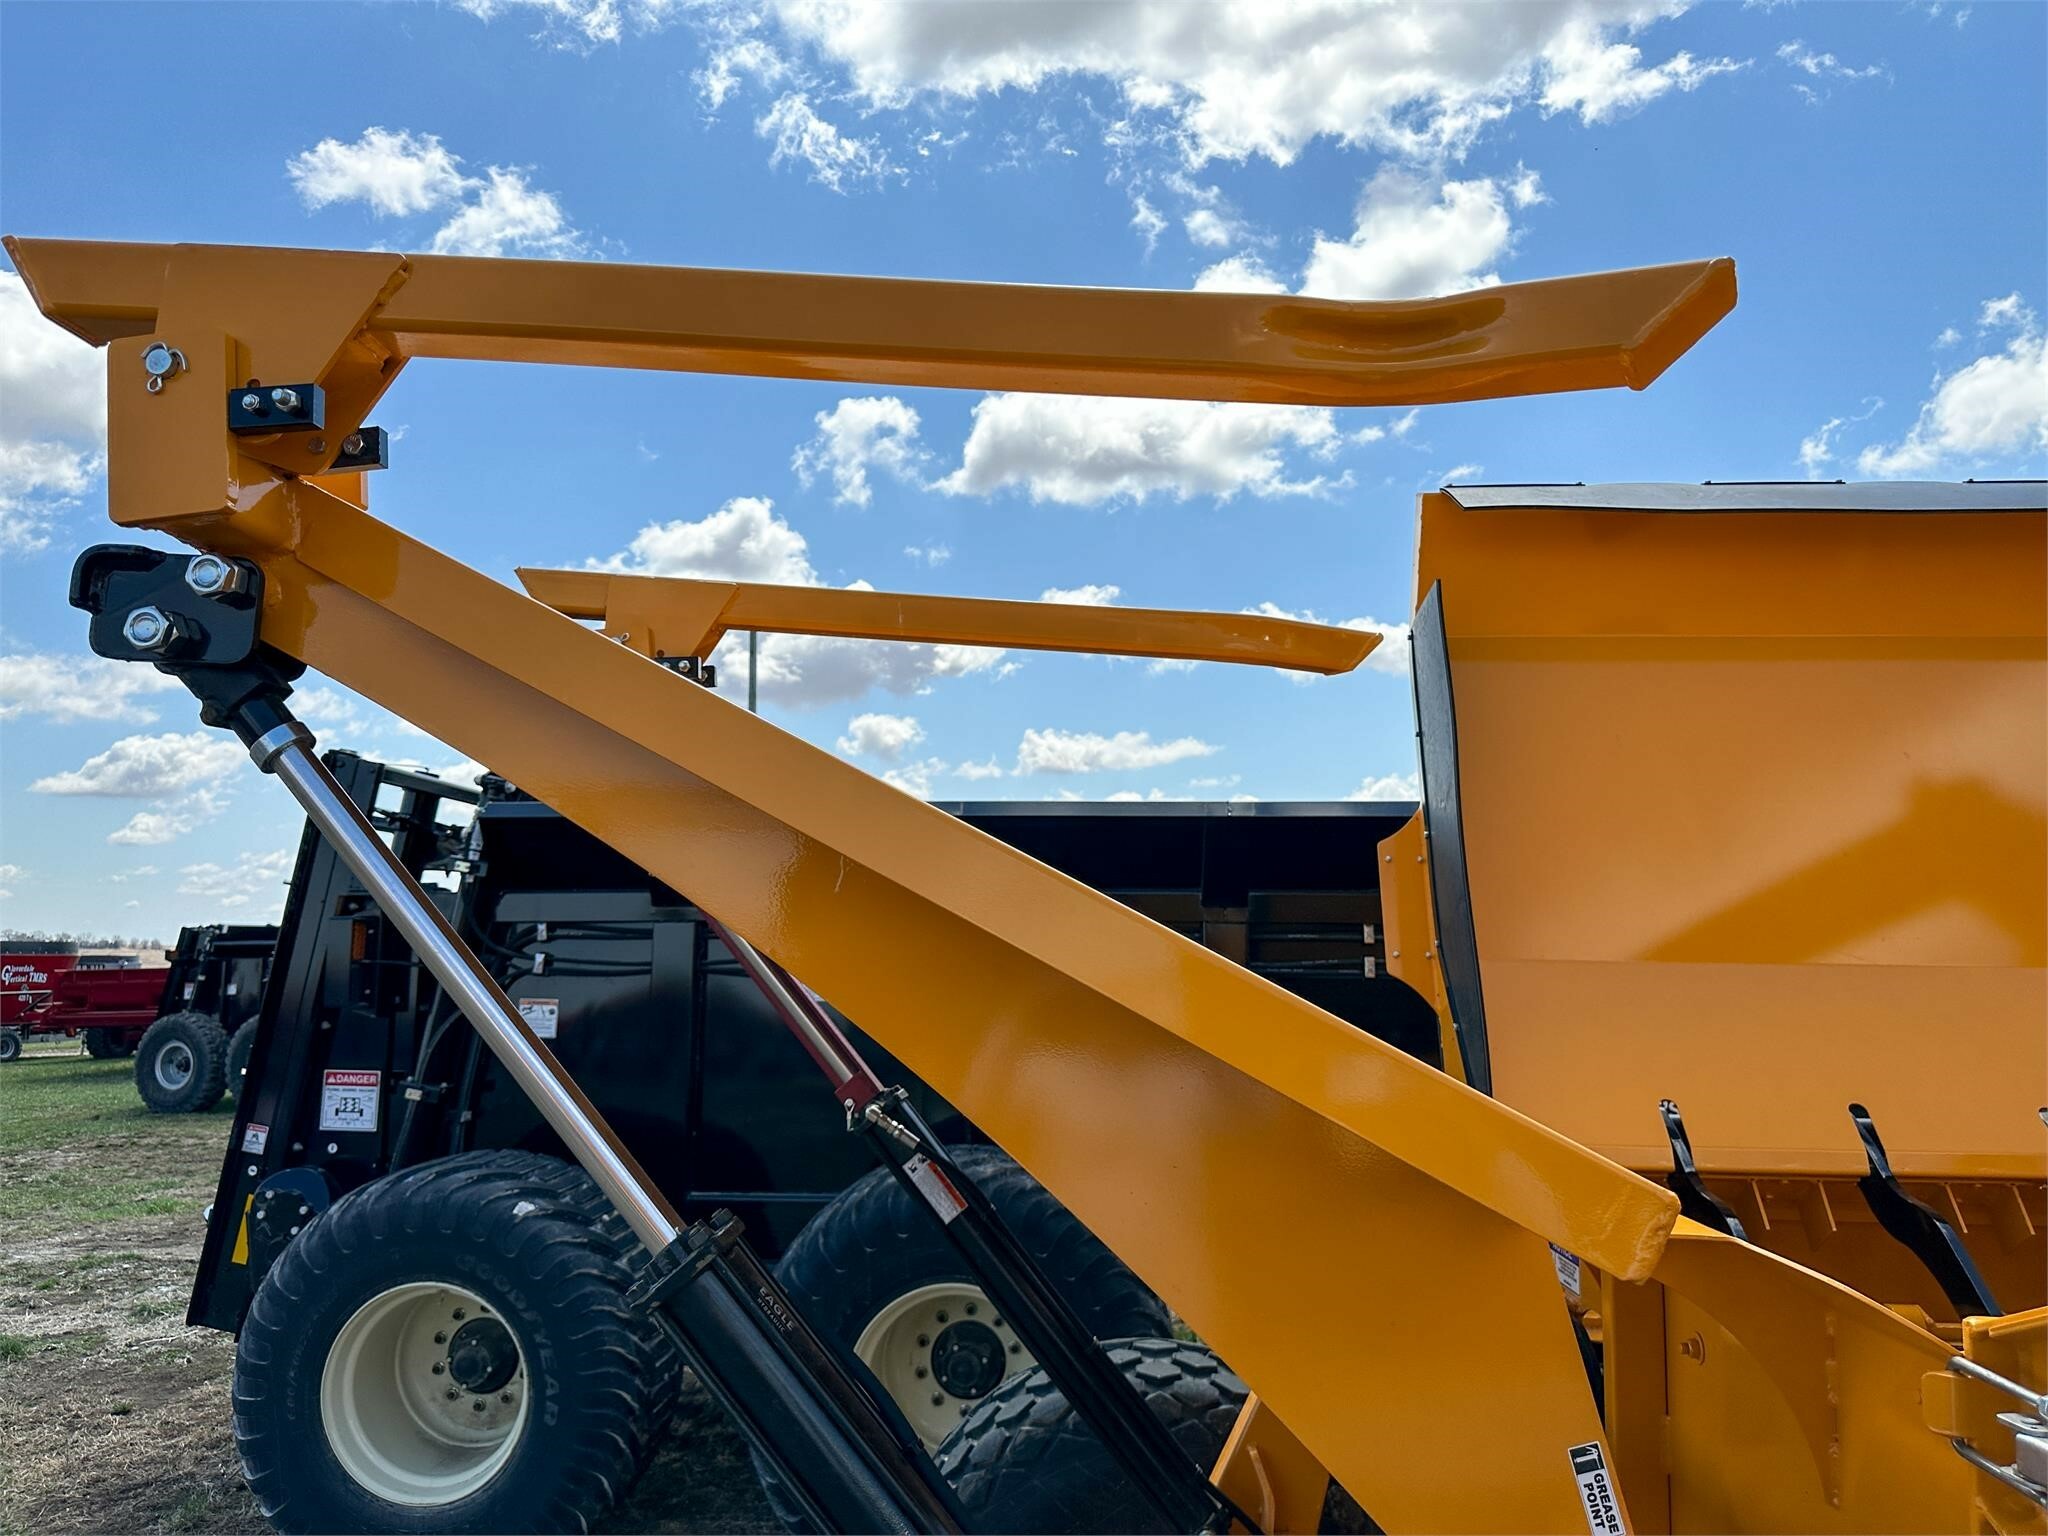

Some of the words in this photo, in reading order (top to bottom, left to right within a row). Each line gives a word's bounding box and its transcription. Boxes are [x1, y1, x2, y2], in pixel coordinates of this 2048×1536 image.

[29, 972, 48, 983] TMRS
[336, 1074, 377, 1084] DANGER
[760, 1286, 794, 1331] EAGLE
[455, 1254, 560, 1427] GOODYEAR
[1583, 1482, 1606, 1529] POINT
[1593, 1473, 1620, 1534] GREASE
